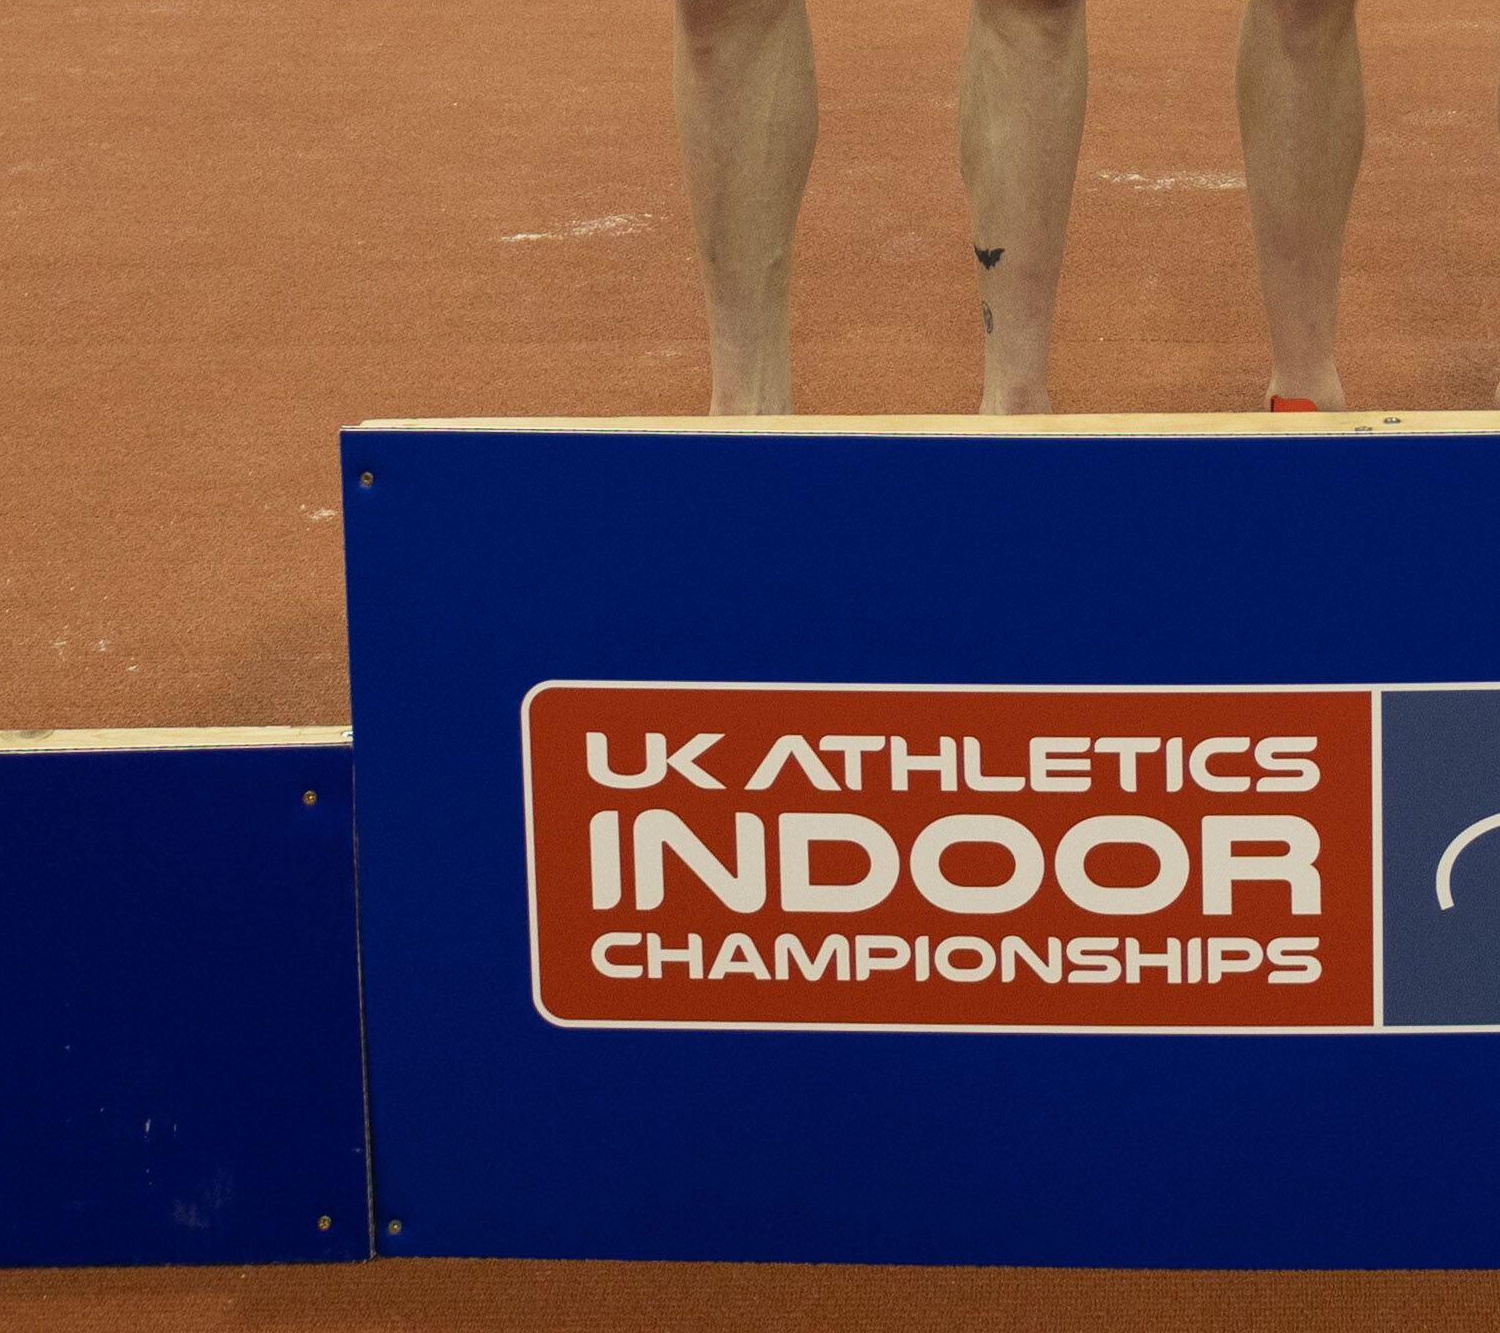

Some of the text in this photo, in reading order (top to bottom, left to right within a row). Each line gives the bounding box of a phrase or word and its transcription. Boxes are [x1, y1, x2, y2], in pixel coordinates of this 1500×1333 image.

[585, 730, 1322, 793] UK ATHLETICS
[590, 813, 1323, 918] INDOOR
[590, 931, 1323, 989] CHAMPIONSHIPS
